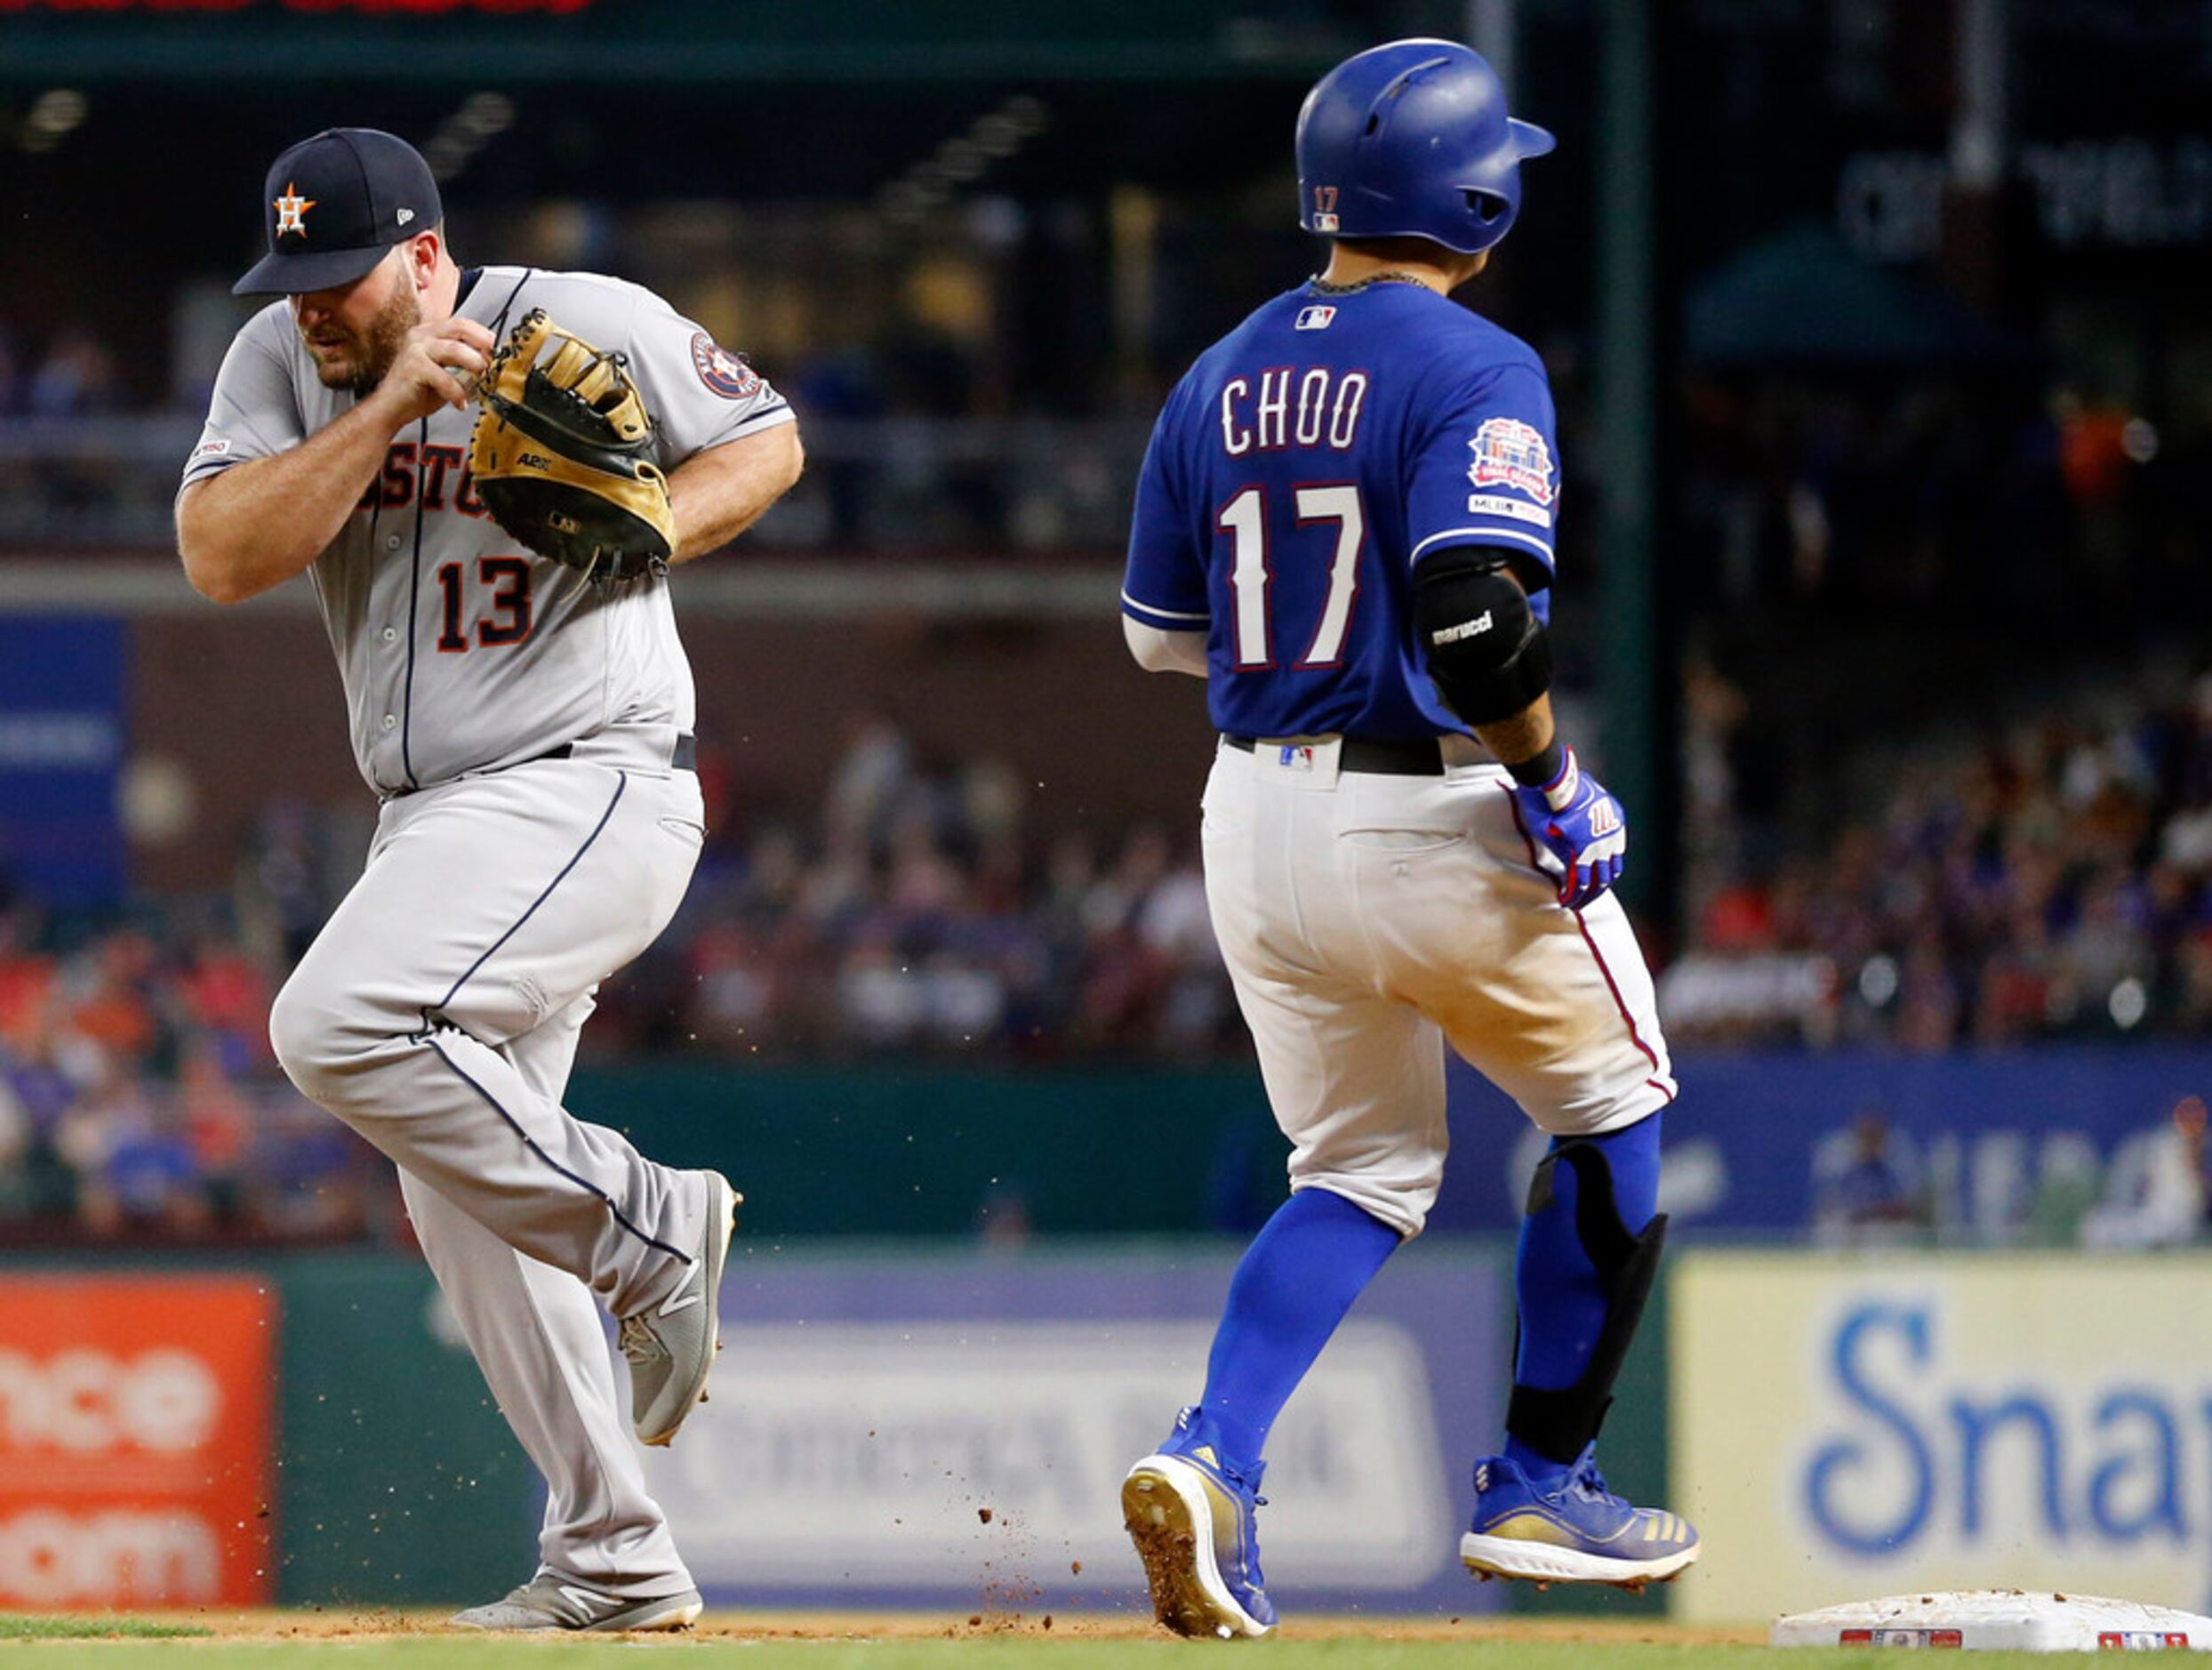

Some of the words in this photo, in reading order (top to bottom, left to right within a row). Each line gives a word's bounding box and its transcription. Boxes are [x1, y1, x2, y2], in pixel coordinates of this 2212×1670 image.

[276, 196, 306, 231] H
[1314, 185, 1338, 213] 17
[1220, 365, 1370, 457] CHOO
[437, 556, 533, 654] 13
[1214, 483, 1370, 671] 17
[1432, 609, 1494, 646] marucci
[1801, 1297, 2212, 1578] Sna
